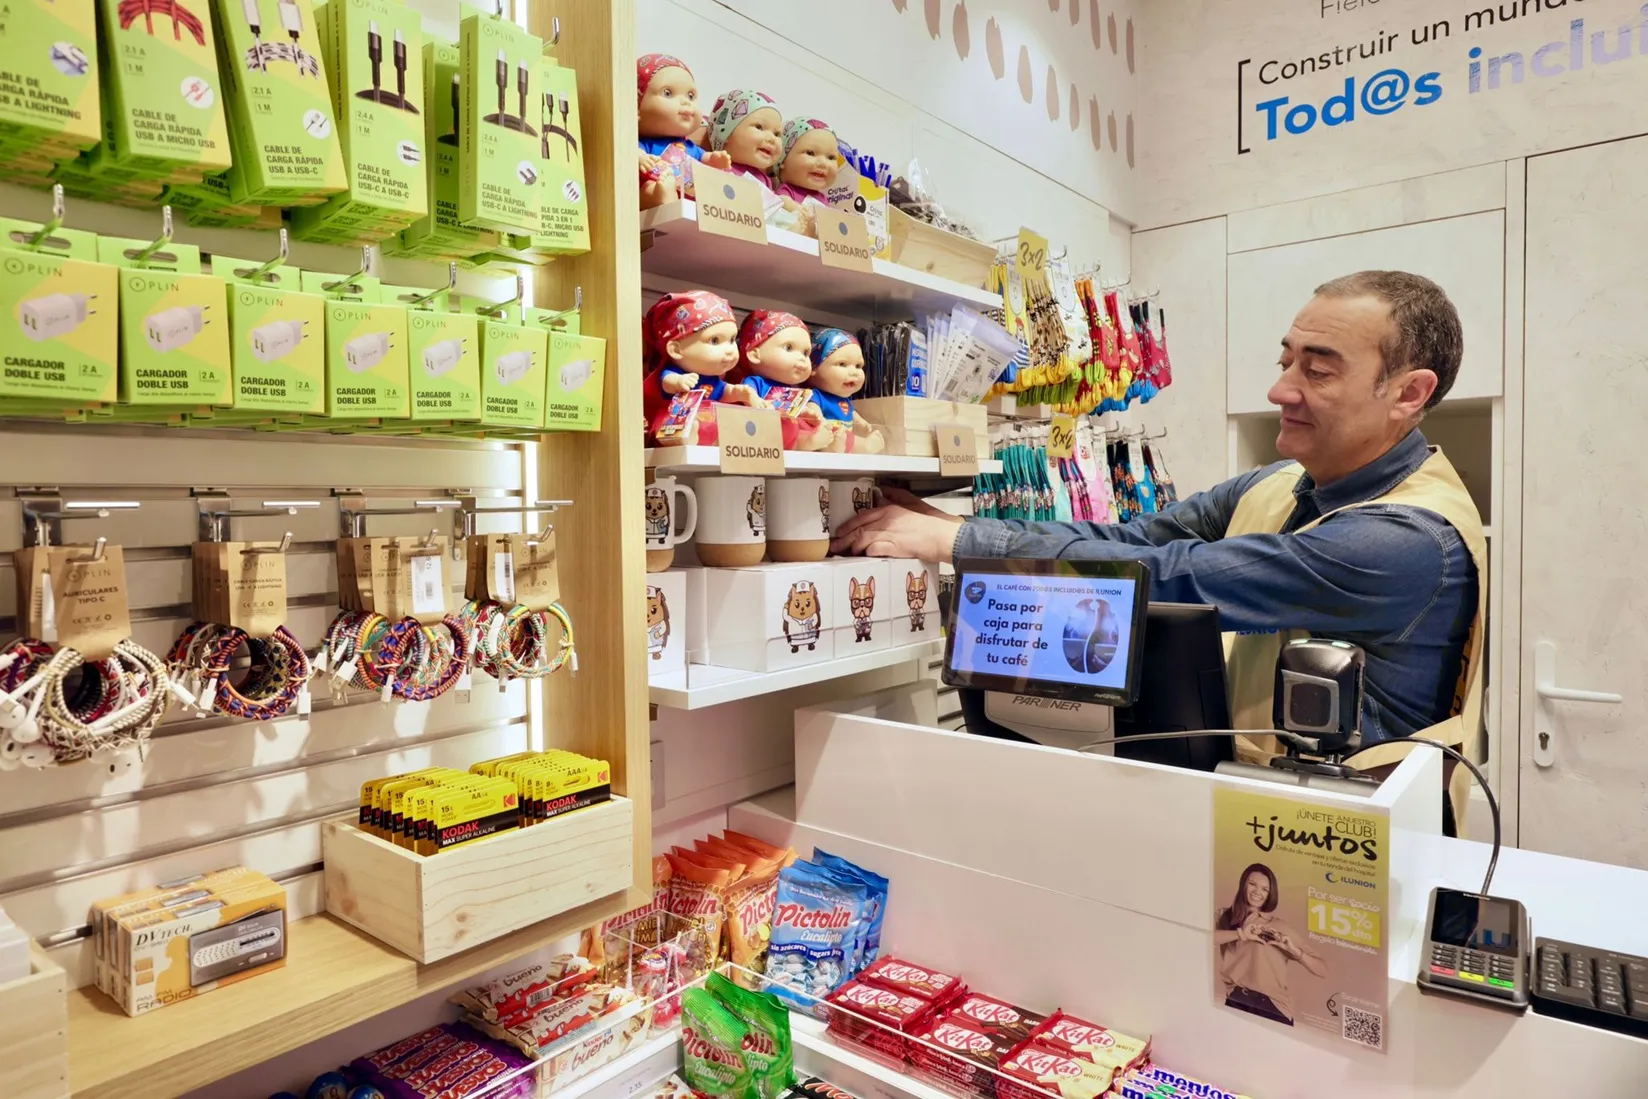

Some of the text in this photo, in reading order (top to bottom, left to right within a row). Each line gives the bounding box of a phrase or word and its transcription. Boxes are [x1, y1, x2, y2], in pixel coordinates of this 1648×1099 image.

[1258, 30, 1399, 84] Construir
[1411, 21, 1450, 46] un
[25, 100, 82, 120] LIGHTNING
[1256, 69, 1443, 140] Tod@s
[132, 108, 177, 122] CABLE DE
[134, 120, 166, 134] CARGA
[135, 131, 216, 149] USB MICRO USB
[264, 145, 289, 154] CABLE
[267, 155, 294, 164] CARGA
[269, 166, 318, 175] USB USB-C
[357, 163, 391, 177] CABLE DE
[358, 173, 381, 184] CARGA
[358, 181, 410, 200] USB-C USB-C
[482, 183, 511, 195] CABLE DE
[482, 192, 502, 202] CARGA
[436, 200, 456, 210] CABLE
[482, 200, 538, 219] USB-C LIGHTNING
[436, 208, 457, 218] CARGA
[703, 204, 762, 229] SOLIDARIO
[824, 241, 869, 260] SOLIDARIO
[1020, 241, 1044, 271] 3x2
[4, 356, 65, 370] CARGADOR
[4, 368, 66, 382] DOBLE USB
[136, 369, 188, 379] CARGADOR
[137, 380, 189, 389] DOBLE USB
[240, 377, 286, 387] CARGADOR
[241, 387, 286, 396] DOBLE USB
[337, 388, 375, 396] CARGADOR
[416, 391, 451, 399] CARGADOR
[337, 396, 376, 404] DOBLE USB
[487, 396, 518, 406] CARGADOR
[486, 405, 518, 414] DOBLE USB
[550, 411, 566, 419] DOBLE
[1051, 425, 1074, 450] 3x2
[725, 445, 780, 460] SOLIDARIO
[943, 454, 976, 465] SOLIDARIO
[63, 586, 119, 598] AURICULARES
[988, 599, 1043, 615] Pasa por
[984, 617, 1042, 632] caja para
[975, 633, 1048, 650] disfrutar de
[987, 653, 1028, 666] tu café
[567, 768, 581, 776] AAA
[546, 795, 577, 811] KODAK
[546, 799, 591, 817] MAX SUPER ALKALINE
[442, 821, 479, 840] KODAK
[442, 825, 496, 846] MAX SUPER ALKALINE
[1335, 821, 1376, 839] CLUB!
[1341, 876, 1376, 889] ILUNION
[1308, 886, 1326, 900] Por
[1329, 894, 1347, 904] ser
[136, 924, 190, 946] DV TECH
[800, 930, 842, 946] Eucalipto
[780, 943, 807, 952] azúcares
[810, 949, 830, 957] sugars
[831, 948, 841, 956] free
[503, 965, 542, 987] bueno
[880, 966, 927, 980] KitKat
[136, 988, 192, 1012] RADIO
[848, 988, 898, 1006] KitKat
[544, 999, 583, 1022] bueno
[967, 1003, 1017, 1021] KitKat
[937, 1029, 990, 1050] KitKat
[1055, 1024, 1113, 1047] KitKat
[571, 1034, 613, 1071] bueno
[1115, 1043, 1136, 1052] WHITE
[1018, 1053, 1080, 1077] KitKat
[1083, 1072, 1104, 1081] WHITE
